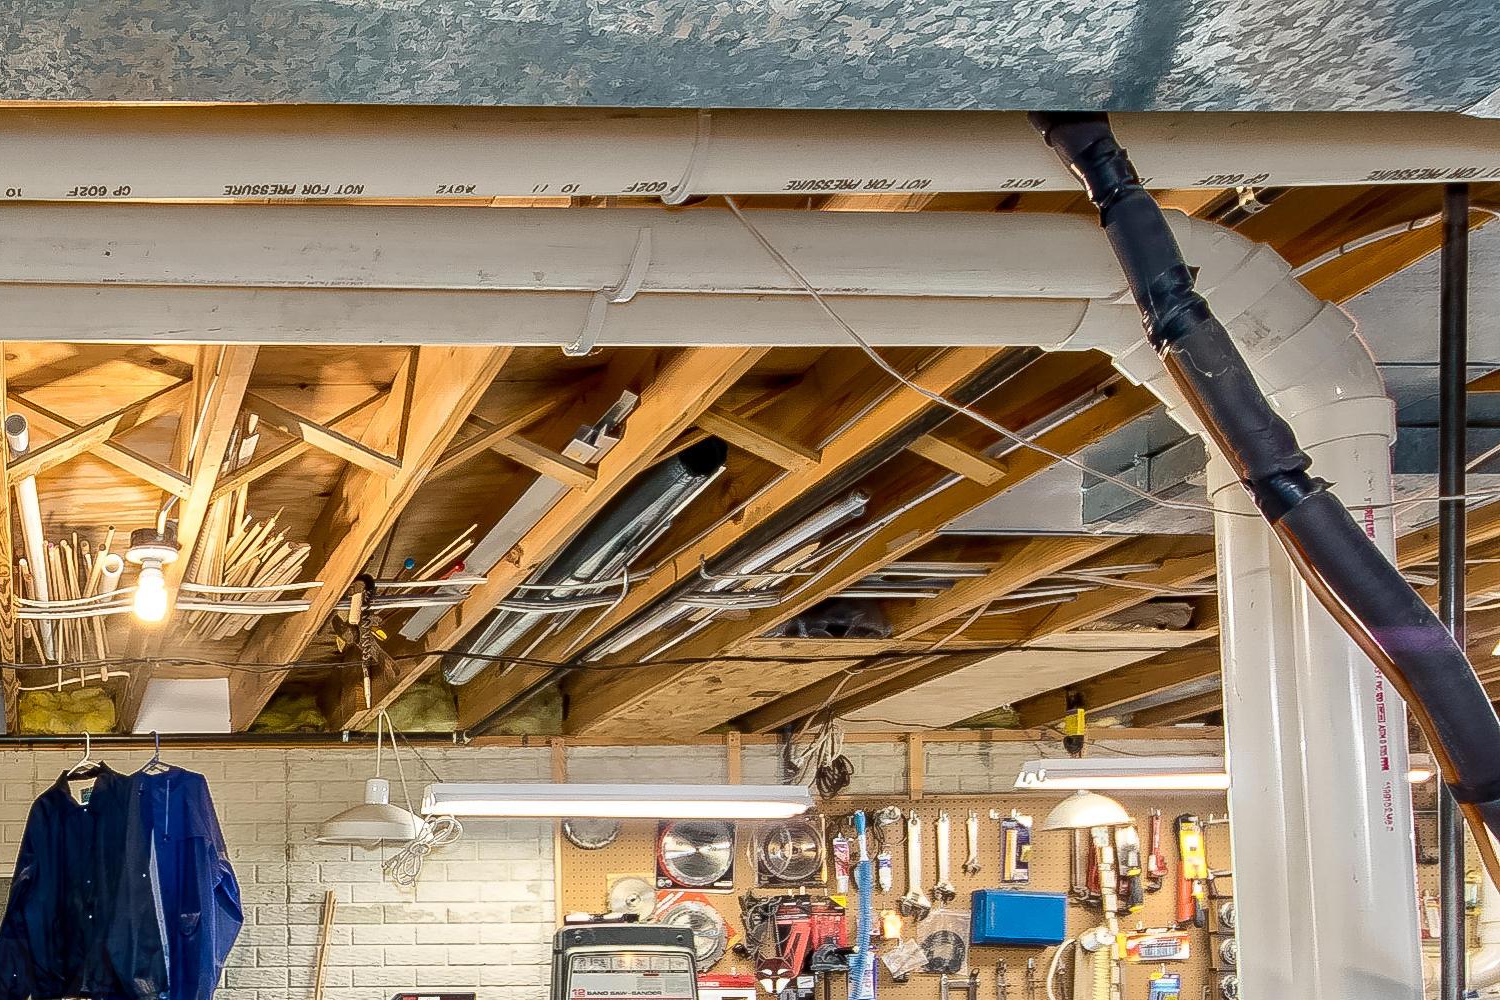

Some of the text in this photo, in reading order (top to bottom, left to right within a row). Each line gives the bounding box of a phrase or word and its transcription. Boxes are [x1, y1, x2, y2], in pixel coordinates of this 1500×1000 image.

[783, 179, 862, 190] PRESSURE
[863, 179, 896, 189] FOR
[896, 178, 932, 188] NOT
[66, 186, 108, 197] 602F
[112, 186, 132, 196] CP
[222, 184, 297, 196] PRESSURE
[301, 185, 330, 195] FOR
[334, 184, 365, 195] NOT
[572, 988, 586, 997] 12
